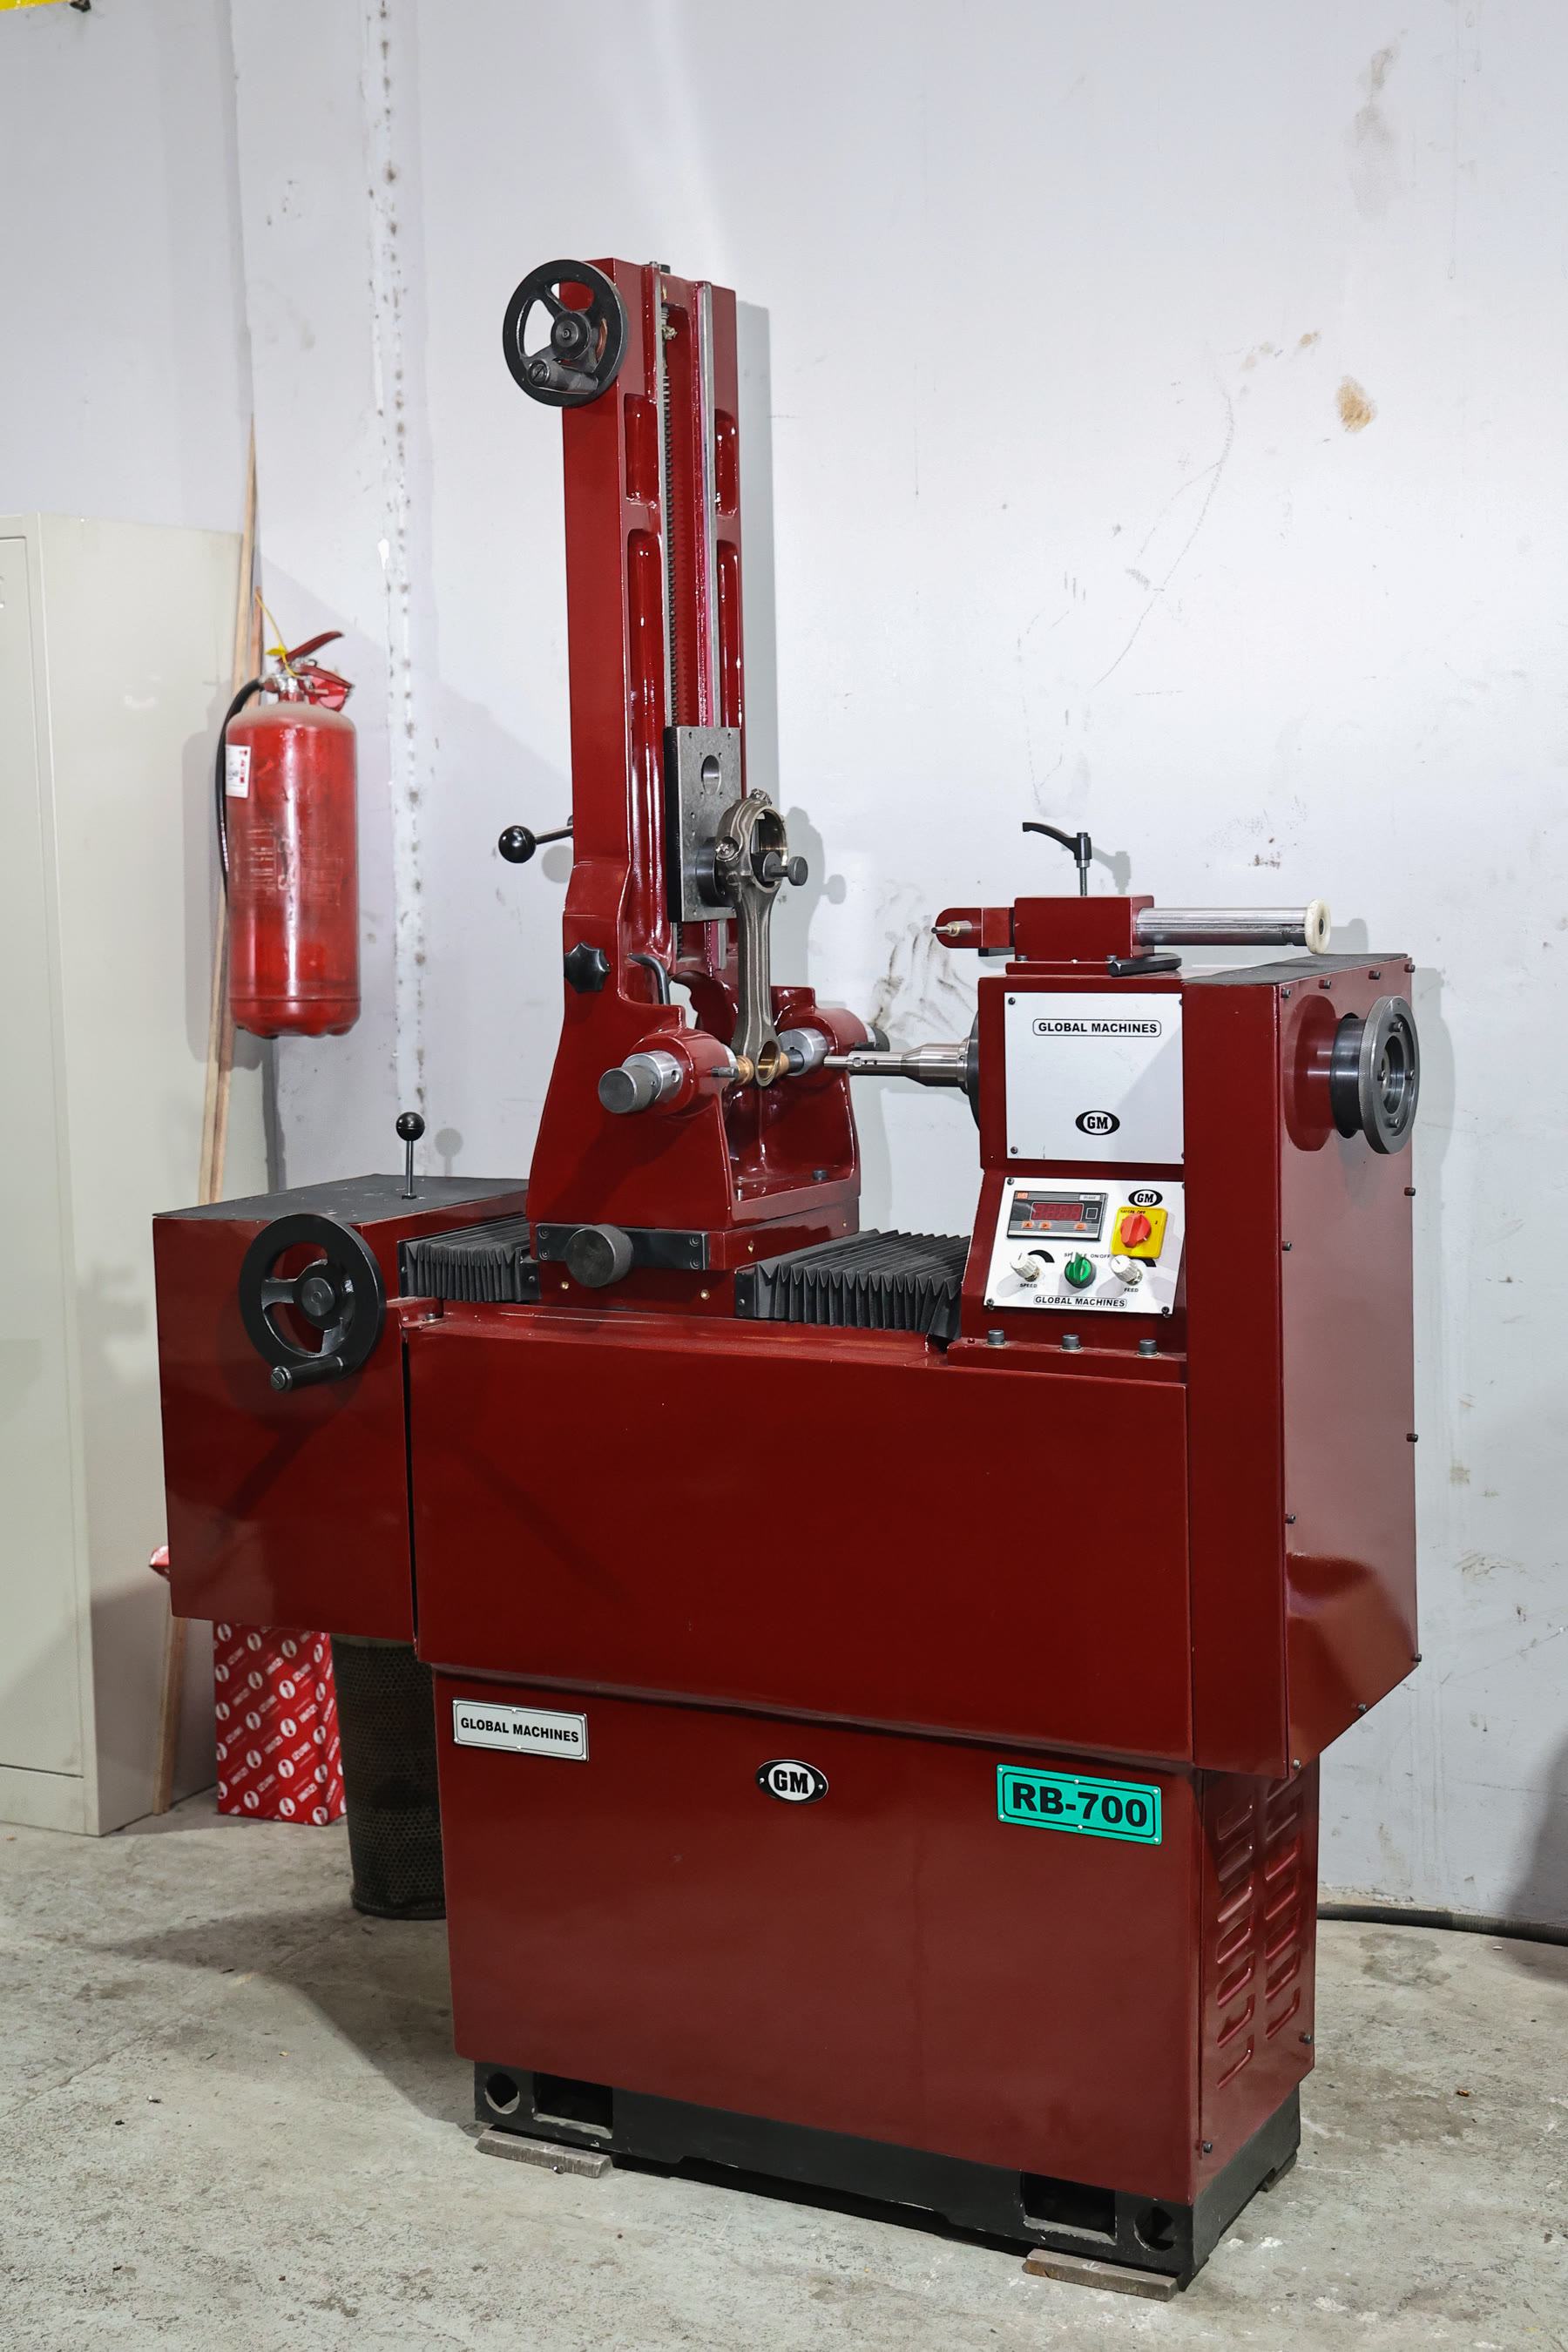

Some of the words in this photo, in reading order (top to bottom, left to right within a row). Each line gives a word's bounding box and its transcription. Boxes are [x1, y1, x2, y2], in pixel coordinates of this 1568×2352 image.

[1038, 1022, 1088, 1032] GLOBAL
[1091, 1023, 1158, 1033] MACHINES
[1087, 1116, 1108, 1129] GM
[1137, 1193, 1154, 1203] GM
[1035, 1296, 1072, 1305] GLOBAL
[1075, 1298, 1125, 1307] MACHINES
[461, 1717, 510, 1734] GLOBAL
[513, 1724, 579, 1742] MACHINES
[773, 1769, 809, 1794] GM
[1012, 1781, 1147, 1828] RB-700
